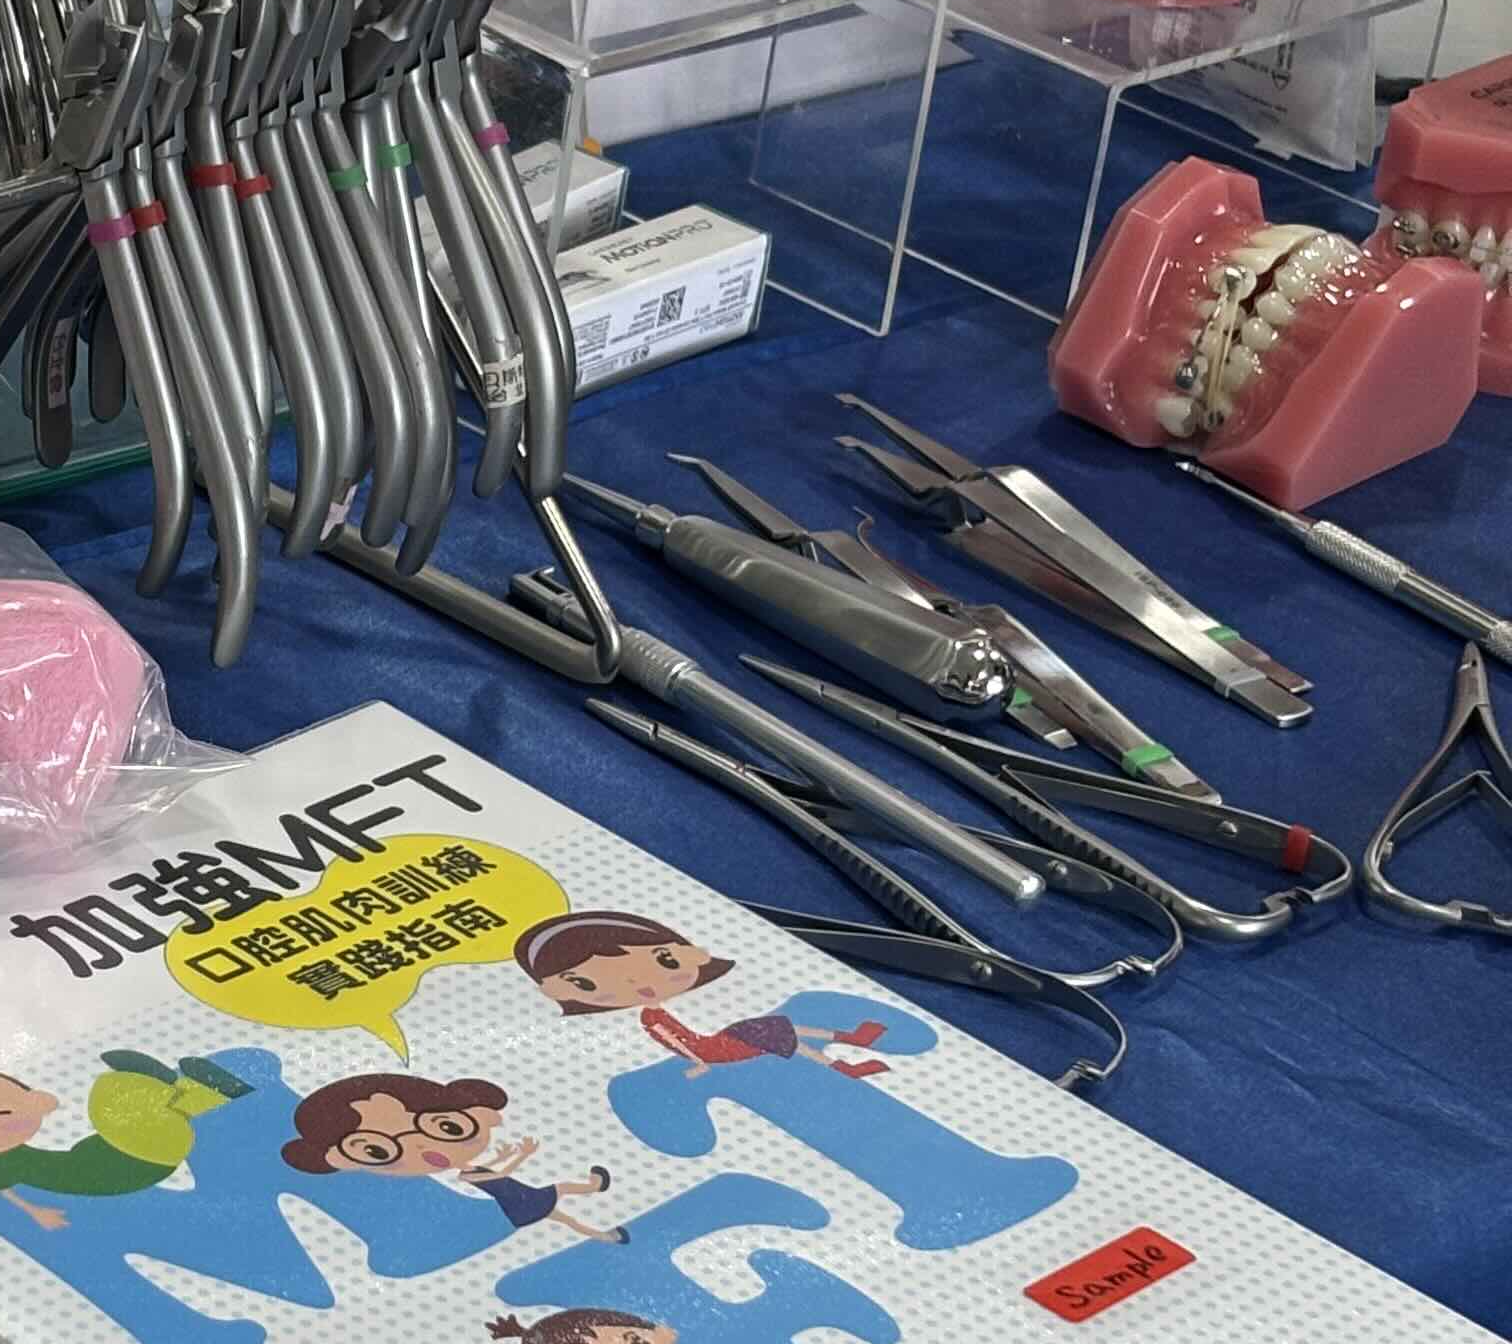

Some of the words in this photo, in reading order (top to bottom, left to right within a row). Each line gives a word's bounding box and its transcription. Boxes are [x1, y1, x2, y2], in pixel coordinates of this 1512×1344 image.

[185, 843, 498, 984] 口腔肌肉訓練
[288, 899, 510, 1002] 實踐指南
[1055, 1243, 1166, 1312] Sample
